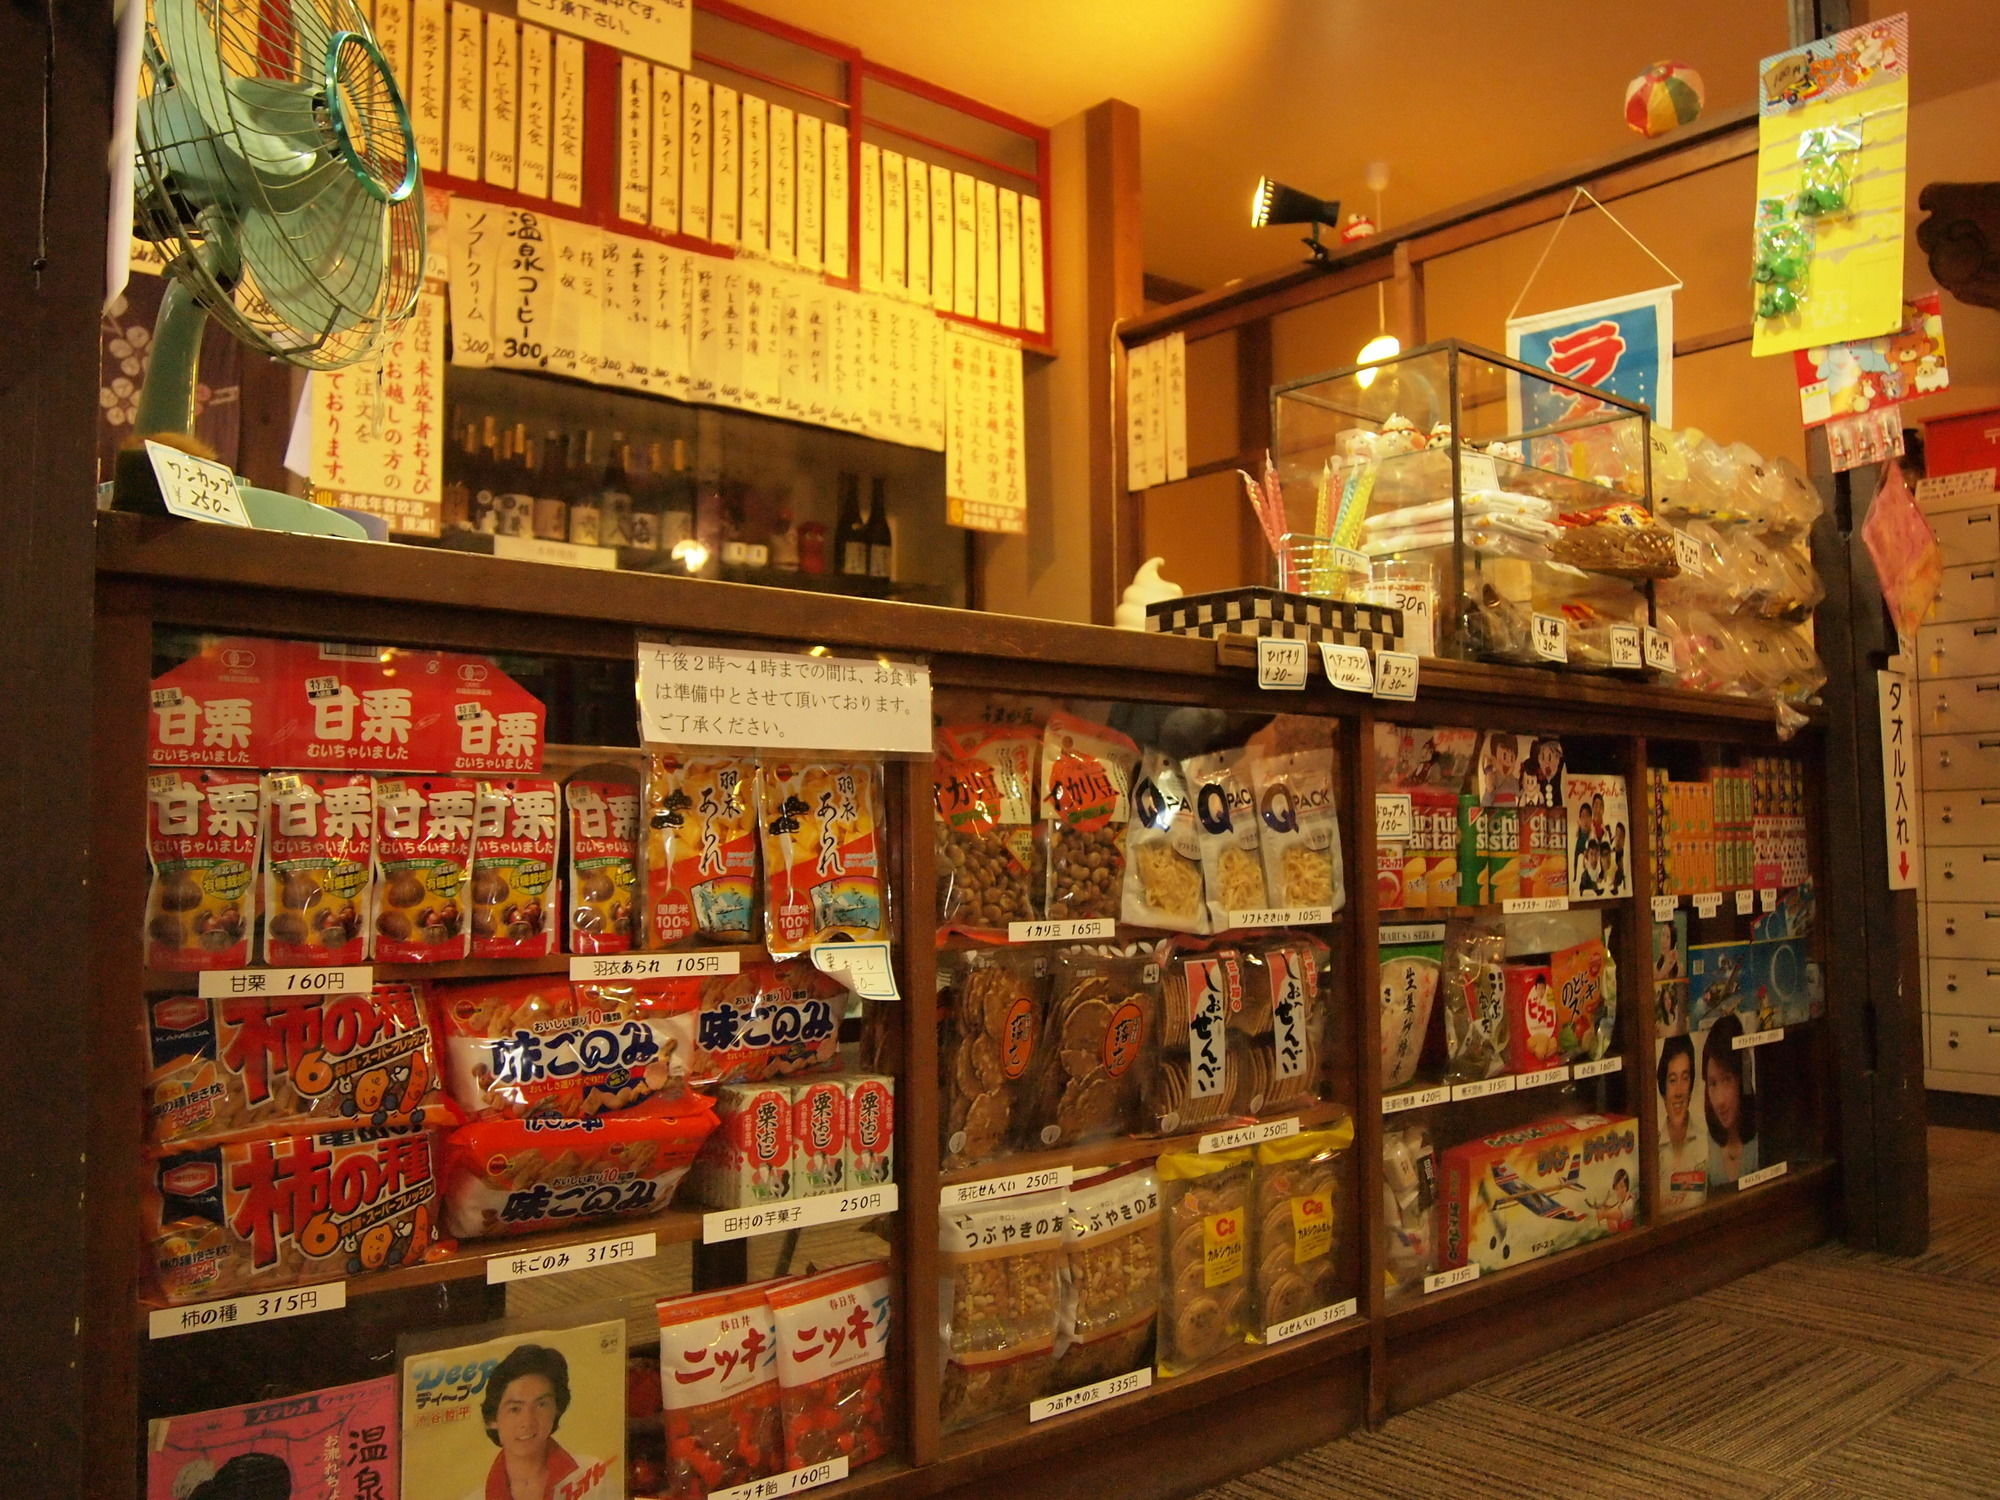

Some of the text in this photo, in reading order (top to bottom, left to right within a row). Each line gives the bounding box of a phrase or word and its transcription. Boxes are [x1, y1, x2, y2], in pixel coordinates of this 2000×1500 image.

[466, 212, 487, 322] ソフトクリーム
[507, 211, 546, 339] 温泉コーヒー
[308, 685, 413, 745] 甘栗
[655, 682, 914, 717] は準備中とさせて頂いております。
[153, 696, 254, 749] 甘栗
[457, 710, 539, 758] 甘栗
[658, 714, 786, 739] ご了承ください。
[152, 749, 250, 764] むいちゃいました
[306, 743, 410, 761] むいちゃいました
[454, 757, 535, 771] むいちゃいました
[1889, 682, 1910, 846] タオル入れ
[152, 782, 261, 837] 甘栗
[271, 784, 373, 838] 甘栗
[377, 789, 476, 841] 甘栗
[1198, 783, 1235, 835] Q
[1261, 783, 1330, 834] Q PACK
[152, 839, 255, 854] むいちゃいました
[271, 840, 370, 855] むいちゃいました
[699, 787, 727, 874] あられ
[817, 792, 844, 874] あられ
[380, 841, 469, 855] むいちゃいました
[655, 916, 690, 928] 100%
[657, 904, 690, 914] 国産米
[779, 916, 810, 930] 100%
[1242, 911, 1322, 925] ソフトさきいか 105円
[662, 929, 683, 939] 使用
[1026, 923, 1102, 938] イカリ豆 165円
[230, 971, 345, 993] 甘栗 160円
[593, 956, 720, 976] 羽衣あられ 105円
[699, 1001, 835, 1051] 味ごのみ
[1528, 996, 1554, 1029] ビスコ
[491, 1021, 660, 1084] 味ごのみ
[1263, 1122, 1290, 1139] 250円
[231, 1135, 432, 1270] 柿の種
[500, 1180, 658, 1223] 味ごのみ
[958, 1171, 1060, 1201] 落花せんべい 250円
[725, 1206, 803, 1233] 田村の芋菓子
[840, 1193, 882, 1215] 250円
[1301, 1199, 1325, 1217] Ca
[966, 1216, 1064, 1248] つぶやきの友
[1215, 1218, 1237, 1237] Ca
[512, 1240, 635, 1276] 味ごのみ 315円
[180, 1291, 318, 1328] 柿の種 315円
[830, 1294, 858, 1312] 春日井
[1322, 1304, 1348, 1322] 315円
[792, 1304, 875, 1363] ニッキ
[675, 1327, 767, 1385] ニッキ
[1046, 1374, 1140, 1413] つぶやきの友 335円
[791, 1465, 831, 1489] 160円
